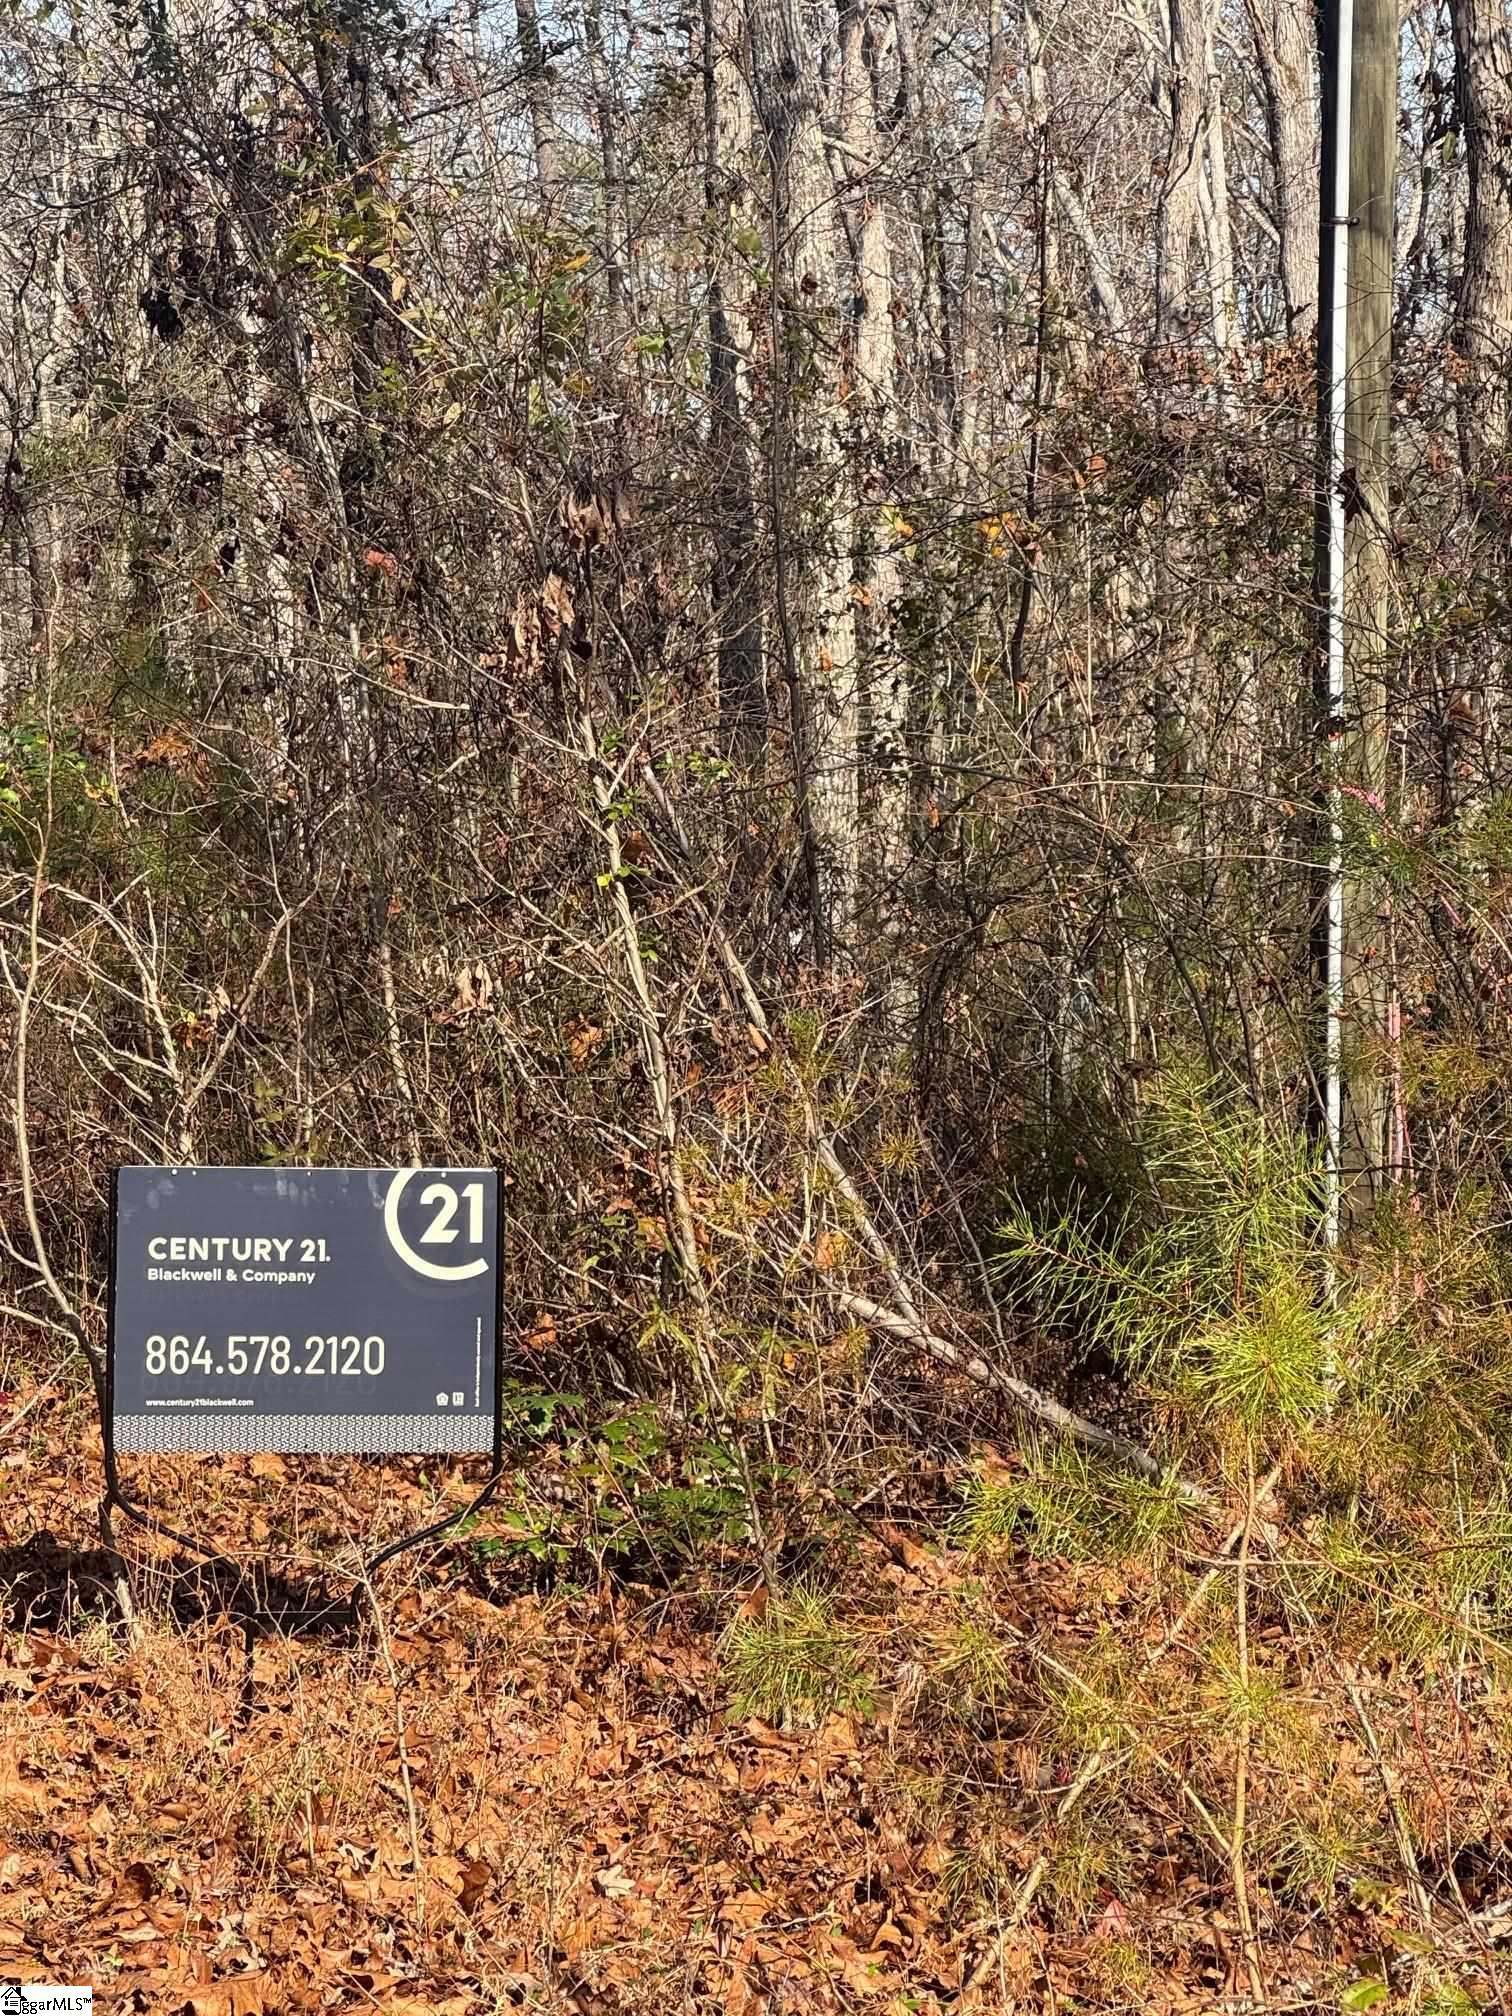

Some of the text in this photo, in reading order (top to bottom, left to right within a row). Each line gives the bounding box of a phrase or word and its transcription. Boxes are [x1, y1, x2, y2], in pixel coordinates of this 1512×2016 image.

[148, 1237, 293, 1262] CENTURY
[147, 1268, 316, 1285] Blackwell & Company
[146, 1335, 385, 1375] 864.578.2120
[146, 1398, 254, 1407] www.century21blackwell.com
